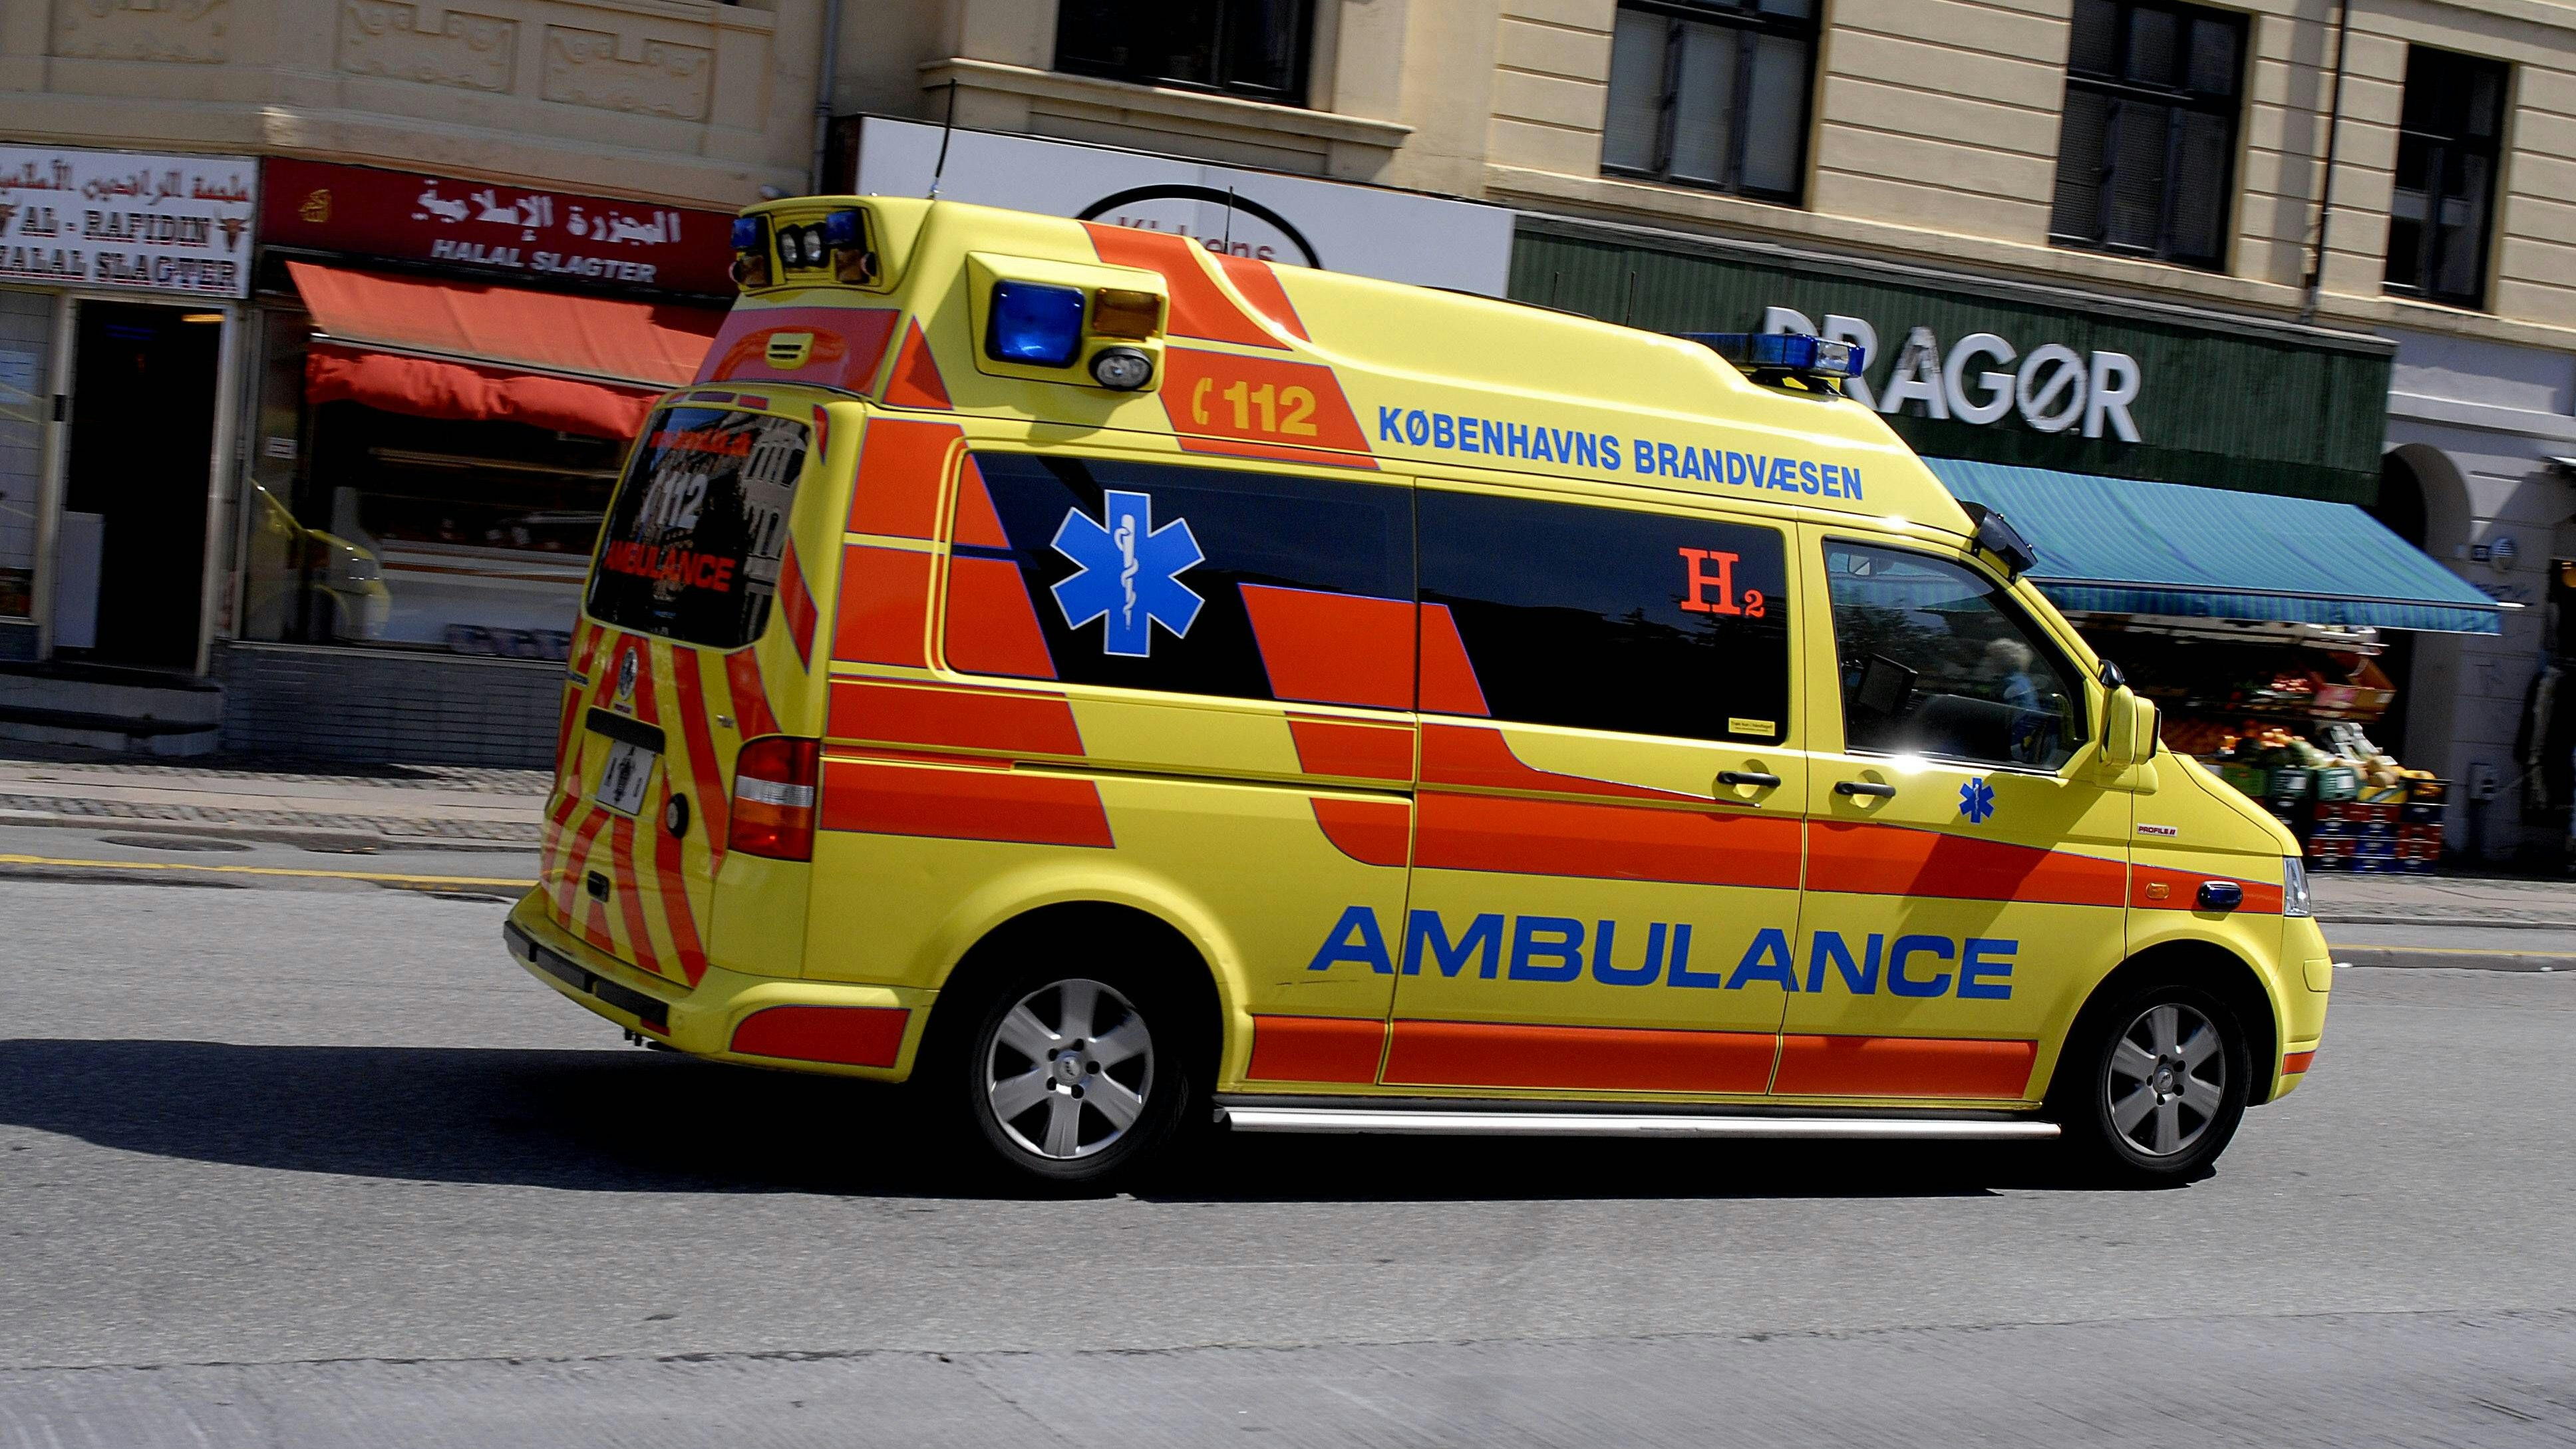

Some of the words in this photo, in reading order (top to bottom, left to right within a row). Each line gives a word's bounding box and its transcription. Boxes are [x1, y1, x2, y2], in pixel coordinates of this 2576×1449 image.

[94, 251, 239, 293] SLAGTER
[430, 238, 525, 267] HALAL
[530, 251, 658, 283] SLAGTER
[1223, 380, 1318, 437] 112
[1378, 405, 1622, 471] KØBENHAVNS
[1635, 439, 1863, 501] BRANDVÆSEN
[640, 468, 709, 530] 112
[602, 540, 736, 593] AMBULANCE
[1306, 904, 2019, 1001] AMBULANCE
